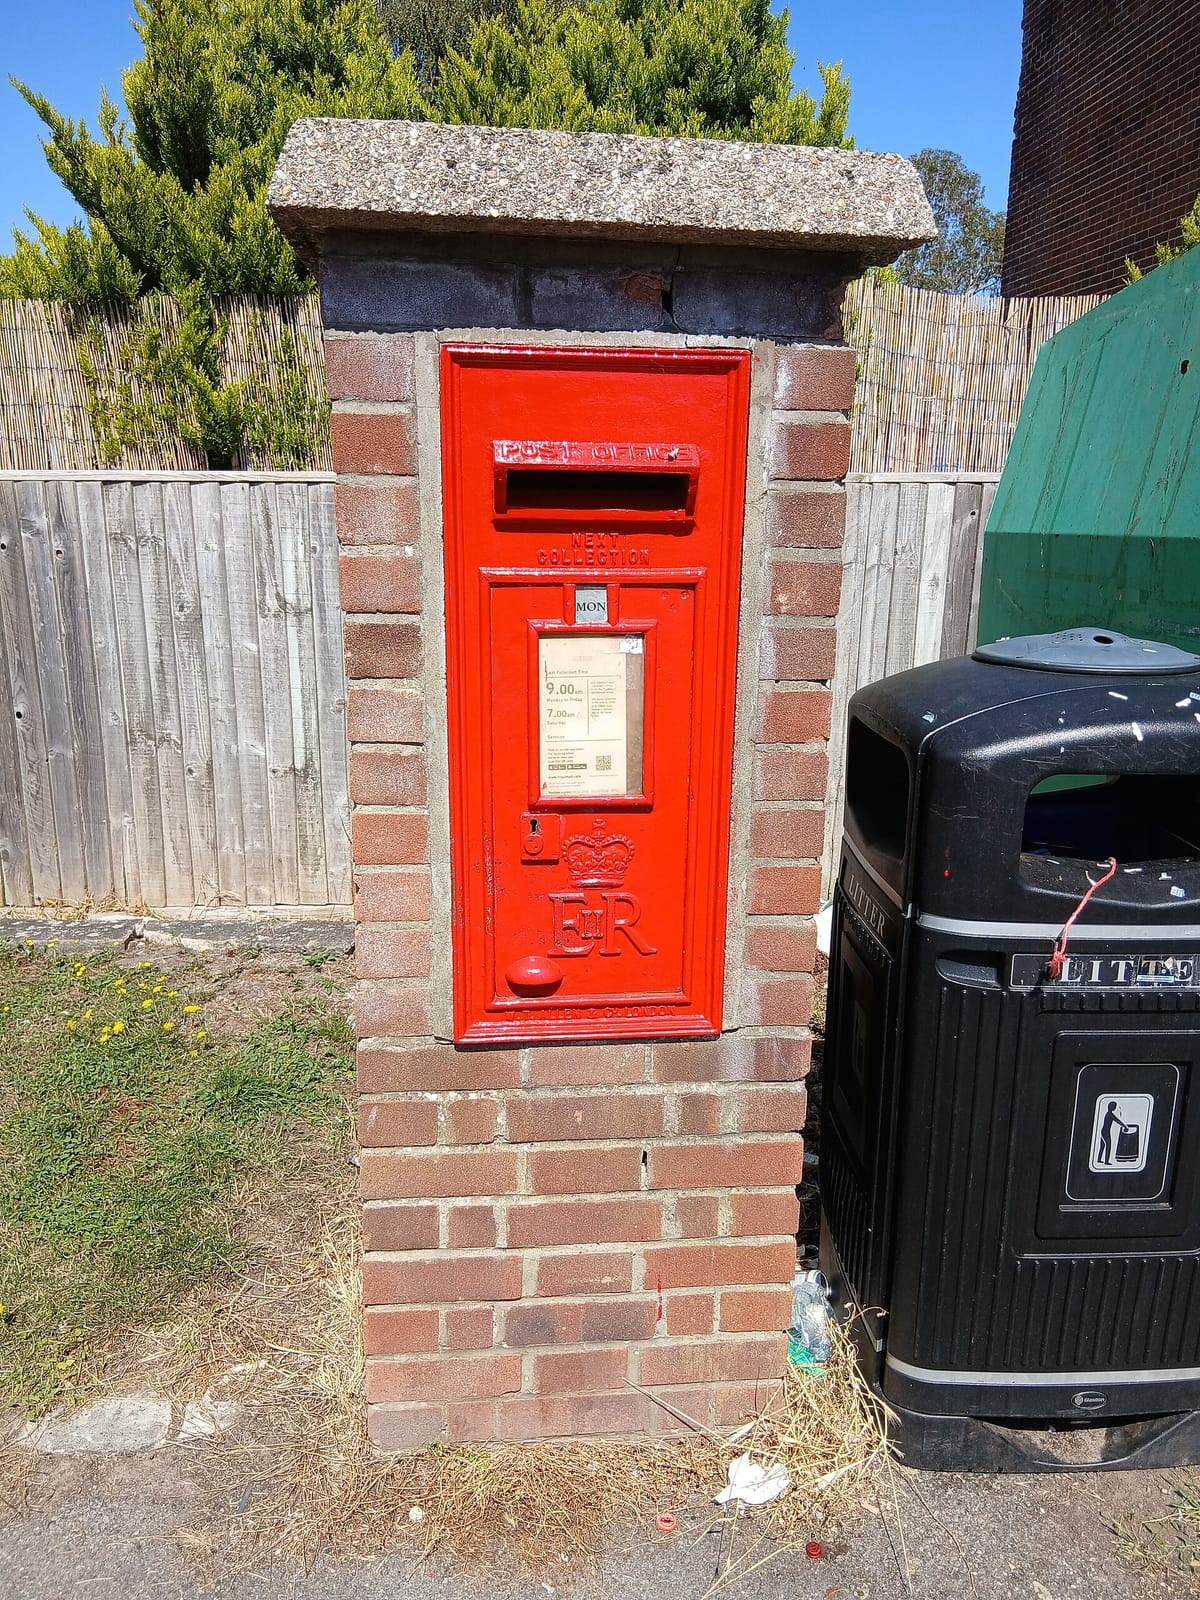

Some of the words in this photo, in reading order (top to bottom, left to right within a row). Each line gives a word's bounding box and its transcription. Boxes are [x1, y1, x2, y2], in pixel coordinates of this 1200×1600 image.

[500, 441, 574, 459] POST
[591, 443, 693, 461] OFFICE
[571, 532, 620, 549] NEXT
[536, 549, 651, 566] COLLECTION
[576, 602, 606, 612] MON
[848, 873, 886, 939] LITTER
[1060, 957, 1193, 982] LITTE
[625, 1004, 677, 1018] LONDON
